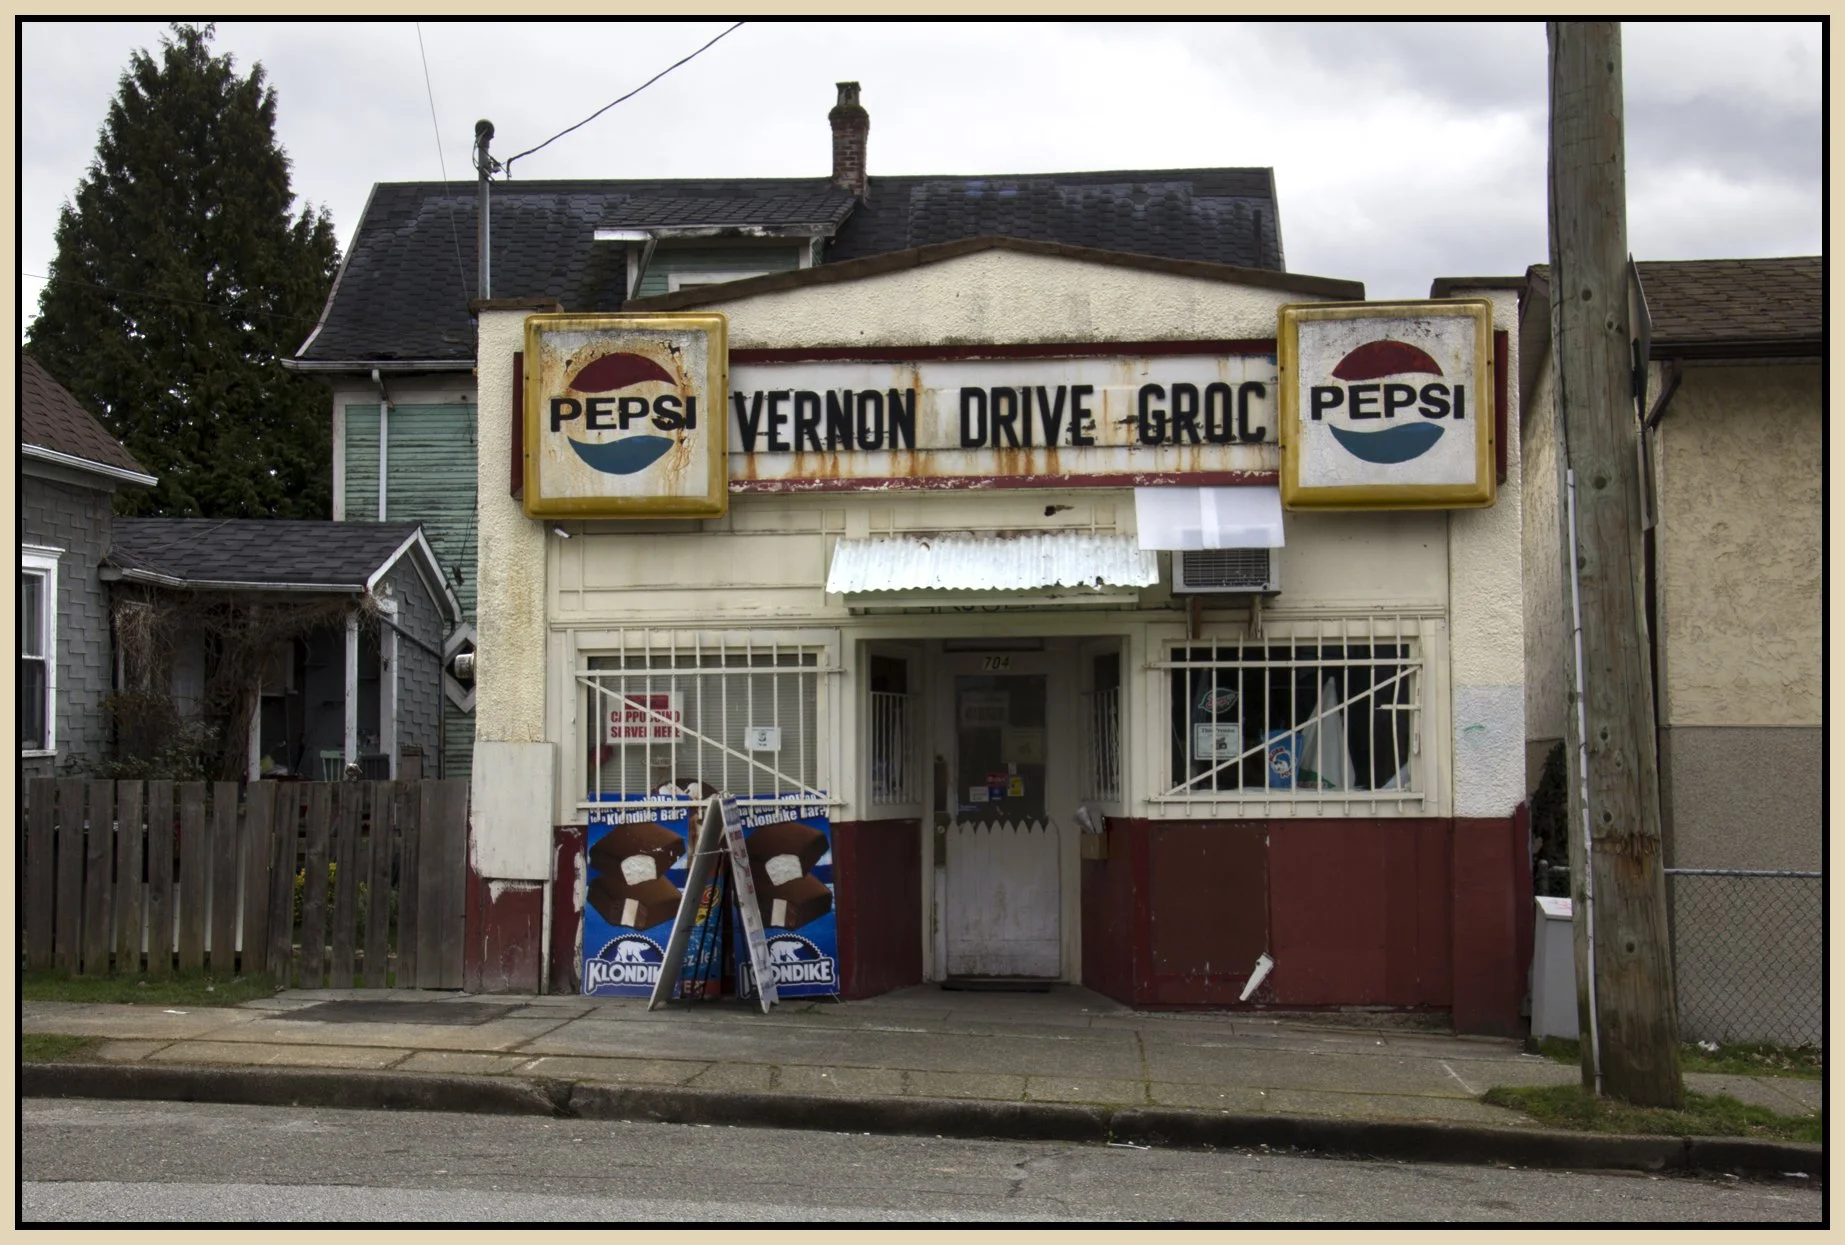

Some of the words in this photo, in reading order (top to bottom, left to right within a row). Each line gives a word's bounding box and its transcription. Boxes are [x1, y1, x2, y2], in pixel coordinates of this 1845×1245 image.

[550, 395, 697, 432] PEPSI
[734, 387, 916, 453] VERNON
[959, 384, 1095, 449] DRIVE
[1138, 381, 1267, 445] GROC
[1311, 382, 1465, 421] PEPSI
[984, 656, 1010, 670] 704
[611, 710, 681, 723] CAPPUCINO
[654, 726, 681, 738] HERE
[588, 962, 662, 992] KLONDIK
[743, 961, 832, 996] KONDIKE
